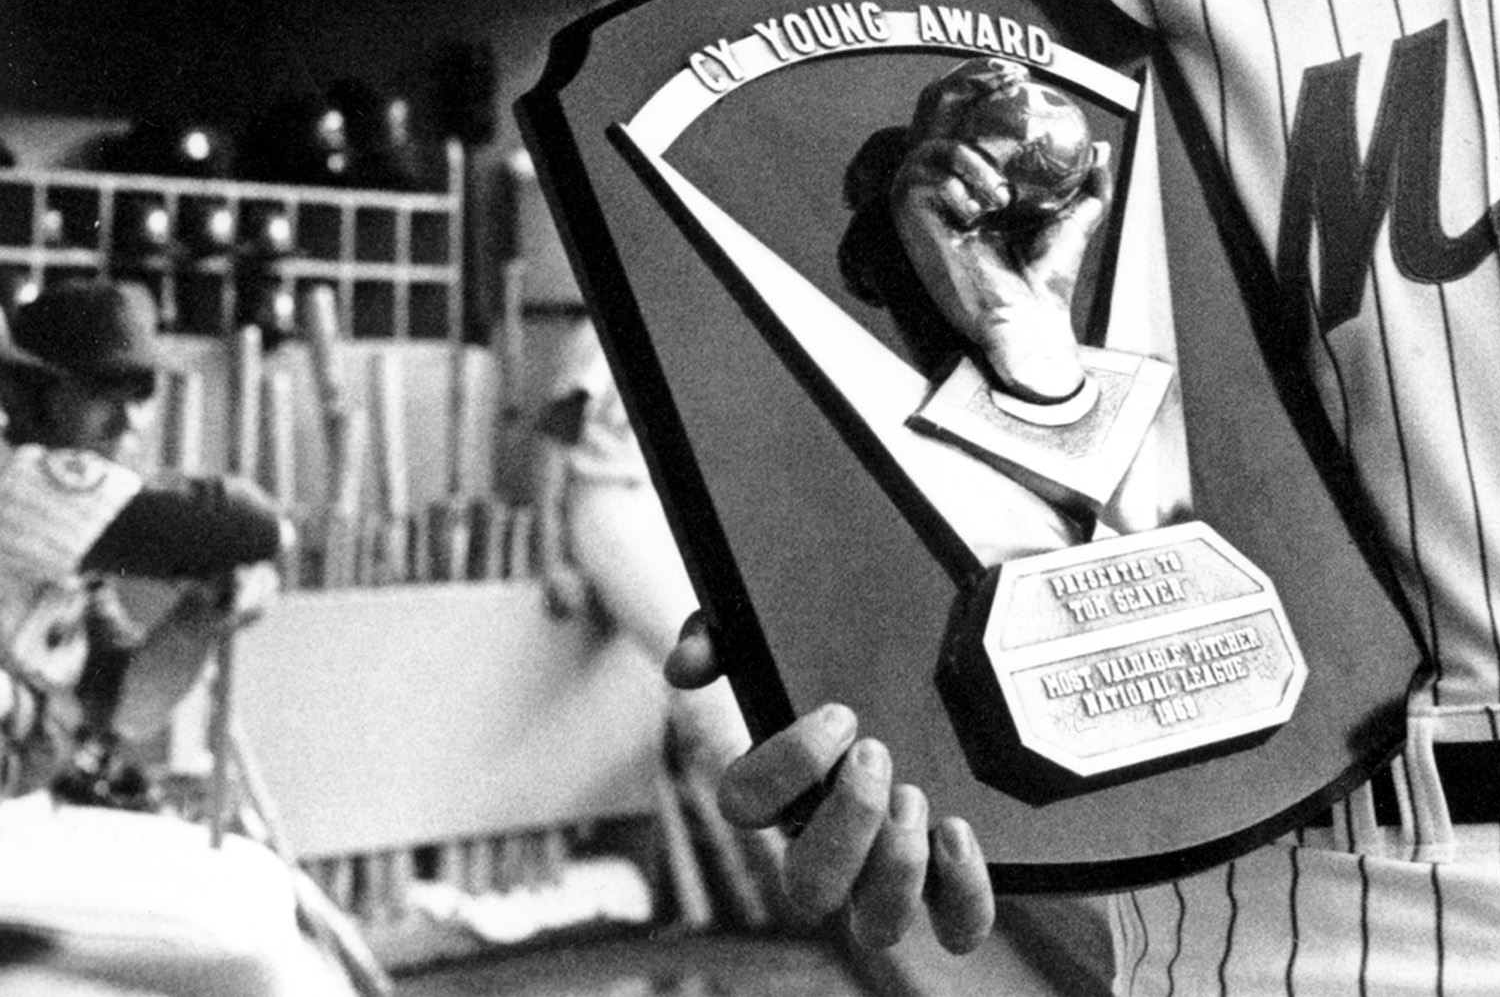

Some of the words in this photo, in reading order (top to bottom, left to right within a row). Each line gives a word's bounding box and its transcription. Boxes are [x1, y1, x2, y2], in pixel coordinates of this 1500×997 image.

[689, 38, 745, 94] CY
[753, 1, 890, 62] YOUNG
[918, 4, 1054, 66] AWARD
[1050, 560, 1155, 598] PRESENTED
[1156, 551, 1183, 573] TO
[1068, 596, 1108, 623] TOM
[1115, 577, 1186, 615] SEAVER
[1041, 666, 1093, 701] MOST
[1097, 645, 1187, 685] VALUABLE
[1187, 626, 1262, 662] PITCHER
[1082, 676, 1179, 718] NATIONAL
[1179, 657, 1249, 694] LEAGUE
[1155, 695, 1199, 726] 1969
